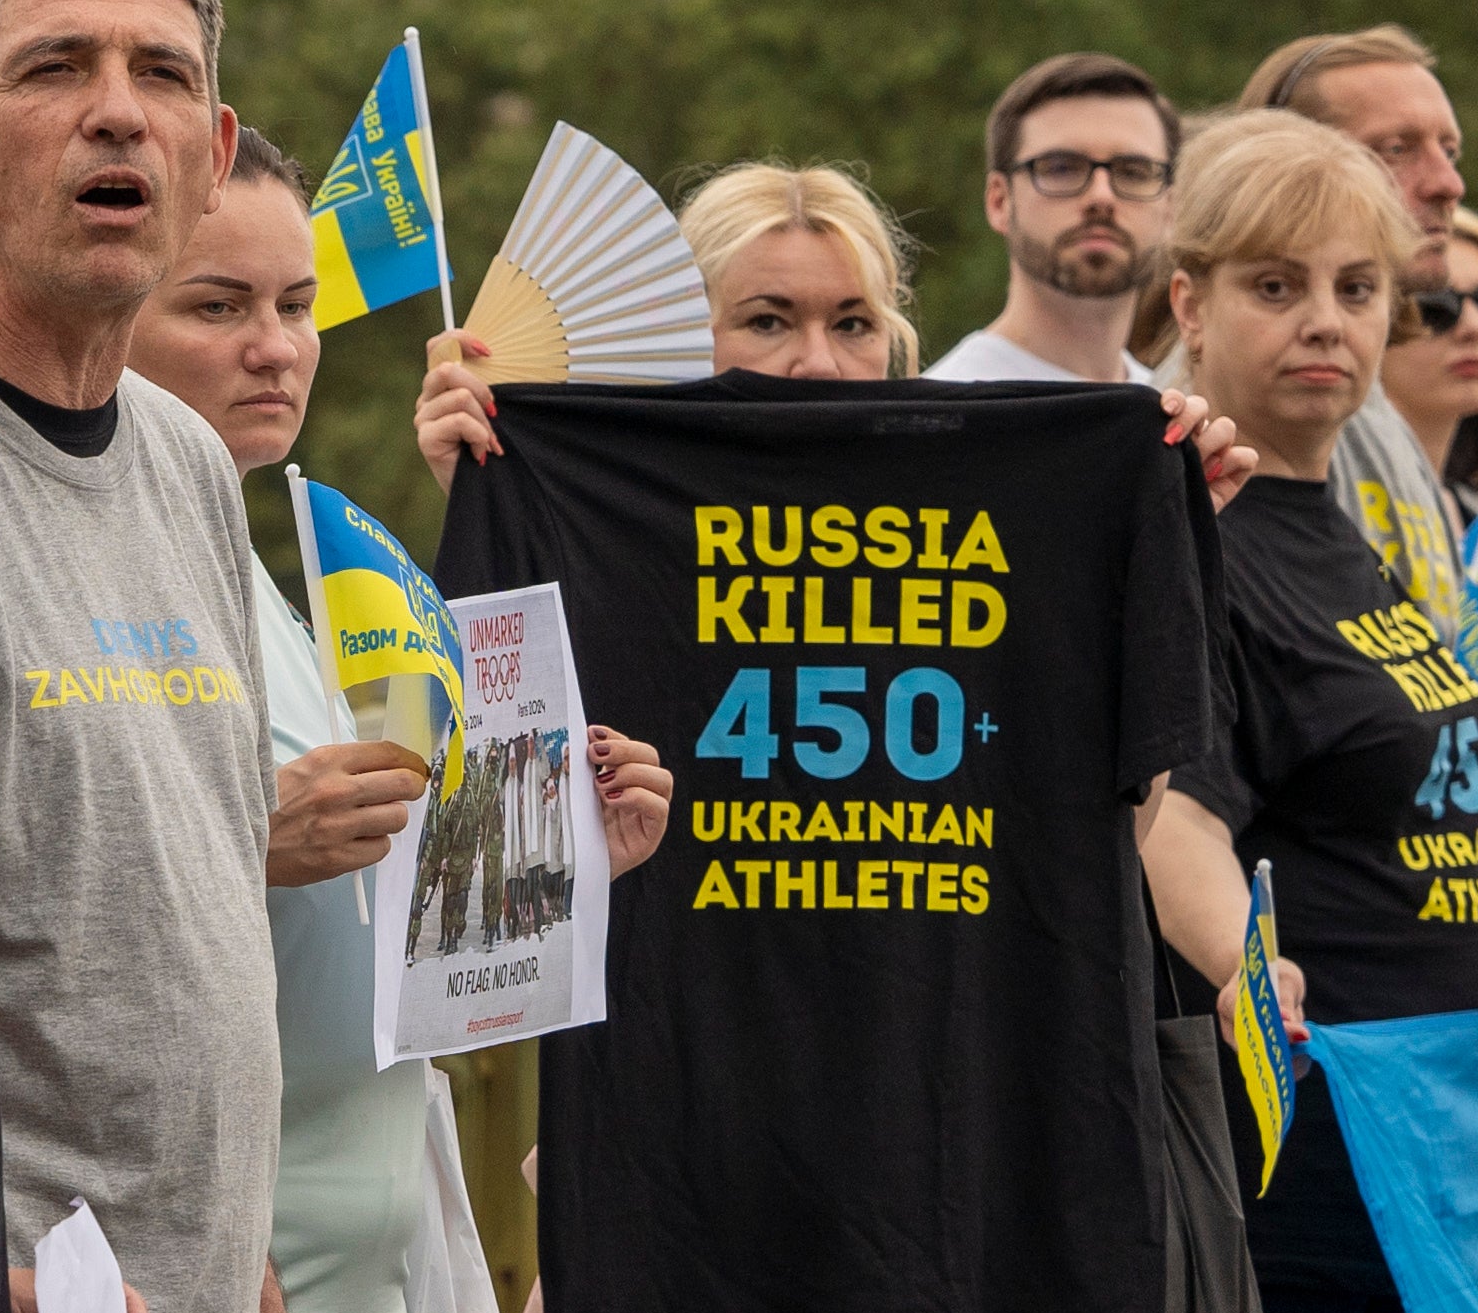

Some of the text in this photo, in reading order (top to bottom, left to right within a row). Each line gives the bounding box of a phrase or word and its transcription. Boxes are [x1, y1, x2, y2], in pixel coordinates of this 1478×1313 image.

[345, 506, 407, 567] Слава
[694, 504, 1010, 573] RUSSIA
[469, 612, 525, 652] UNMARKED
[697, 576, 1008, 648] KILLED
[91, 617, 199, 659] DENYS
[339, 628, 397, 659] Разом
[474, 651, 521, 691] TROOPS
[469, 714, 483, 729] 2014
[517, 699, 546, 718] Paris 2024
[695, 666, 999, 781] 450+
[692, 801, 994, 849] UKRAINIAN
[692, 860, 990, 915] ATHLETES
[446, 956, 540, 999] NO FLAG. NO HONOR.
